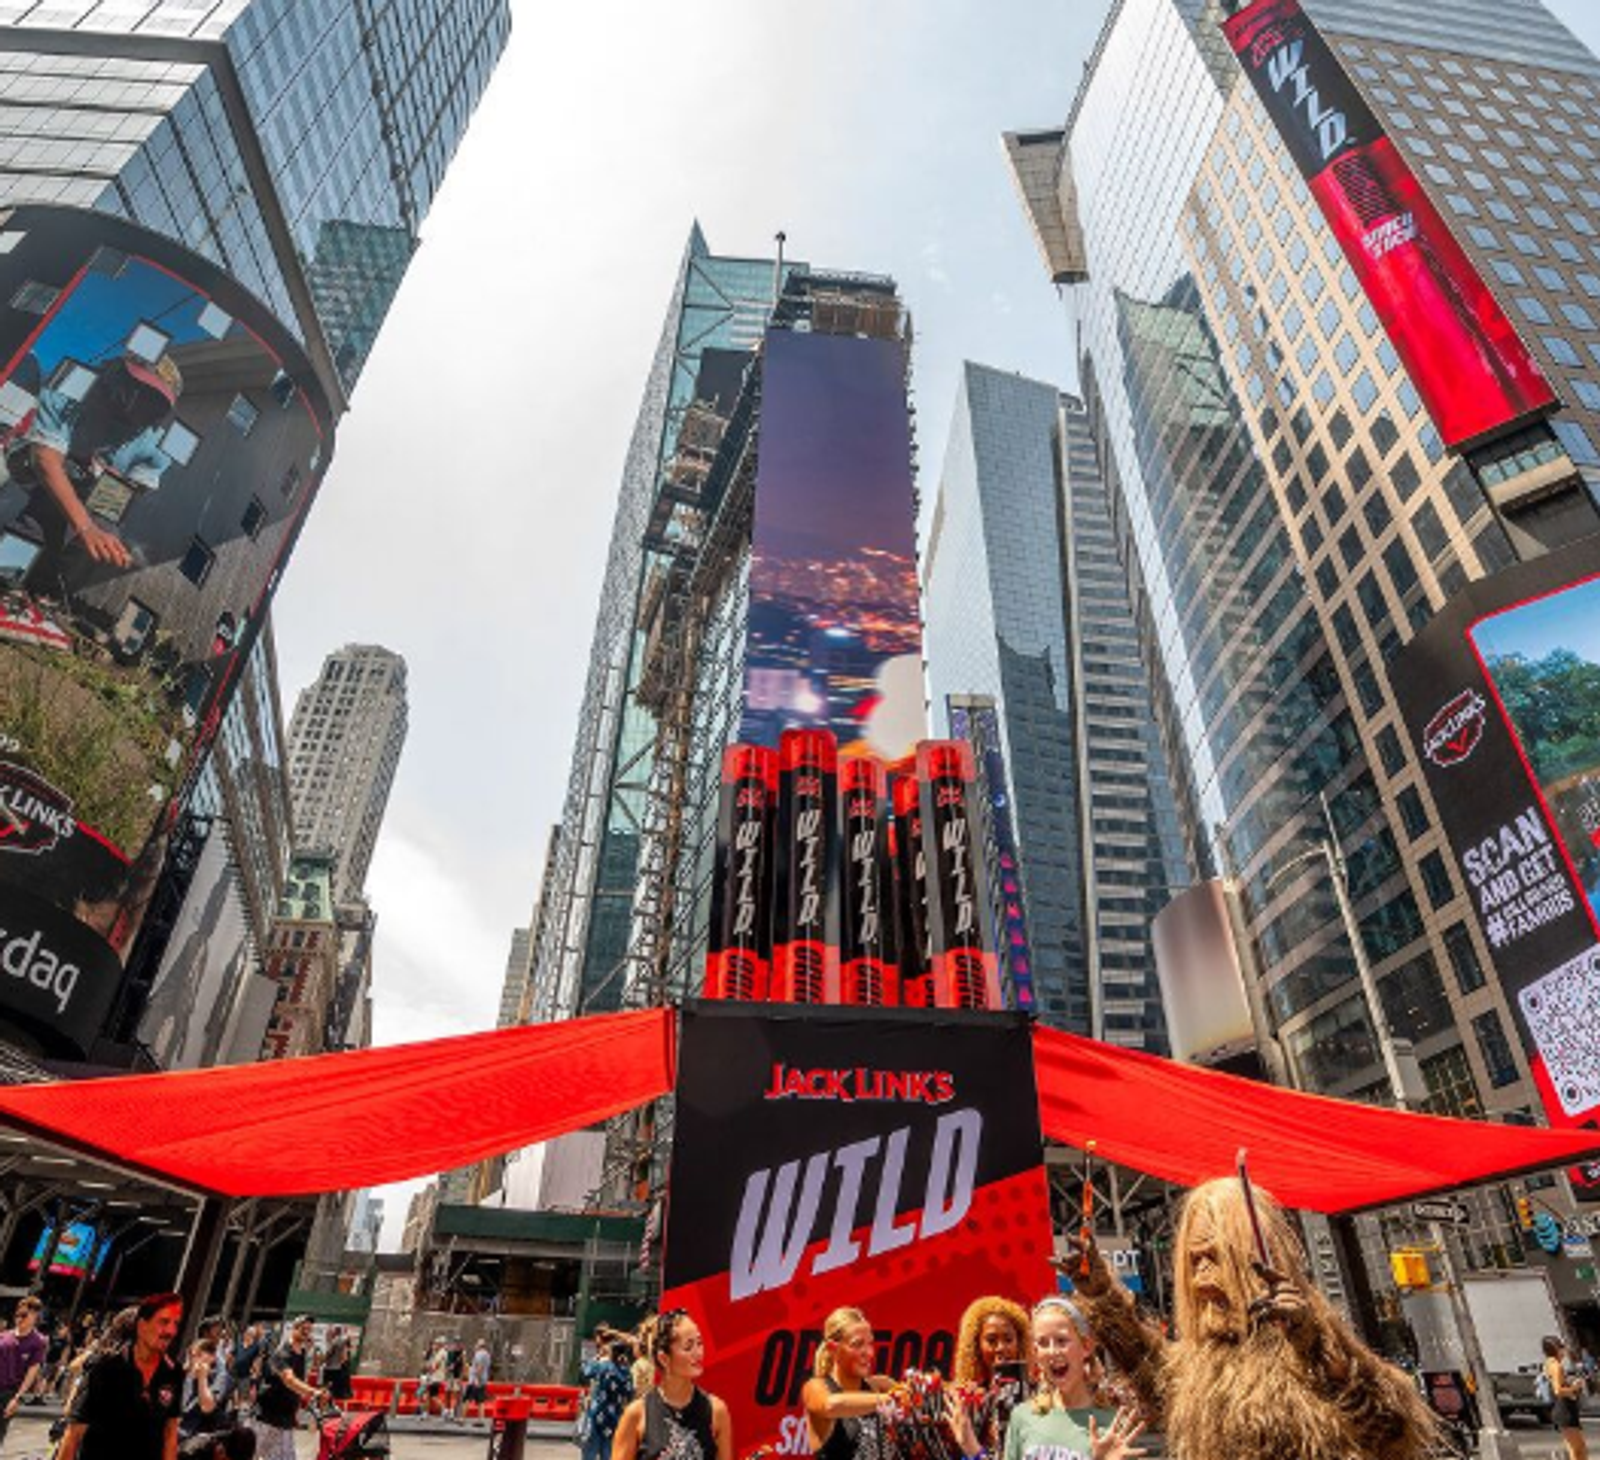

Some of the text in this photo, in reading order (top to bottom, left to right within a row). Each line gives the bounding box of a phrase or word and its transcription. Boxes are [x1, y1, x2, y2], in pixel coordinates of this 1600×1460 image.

[1268, 39, 1346, 160] WILD
[735, 821, 761, 934] WILD
[797, 809, 821, 925] WILD
[852, 830, 876, 944] WILD
[943, 817, 973, 935] WILD
[1463, 806, 1547, 887] SCAN
[1481, 843, 1556, 914] AND GET
[0, 928, 79, 1014] daq
[763, 1061, 853, 1102] JACK
[730, 1107, 984, 1302] WILD
